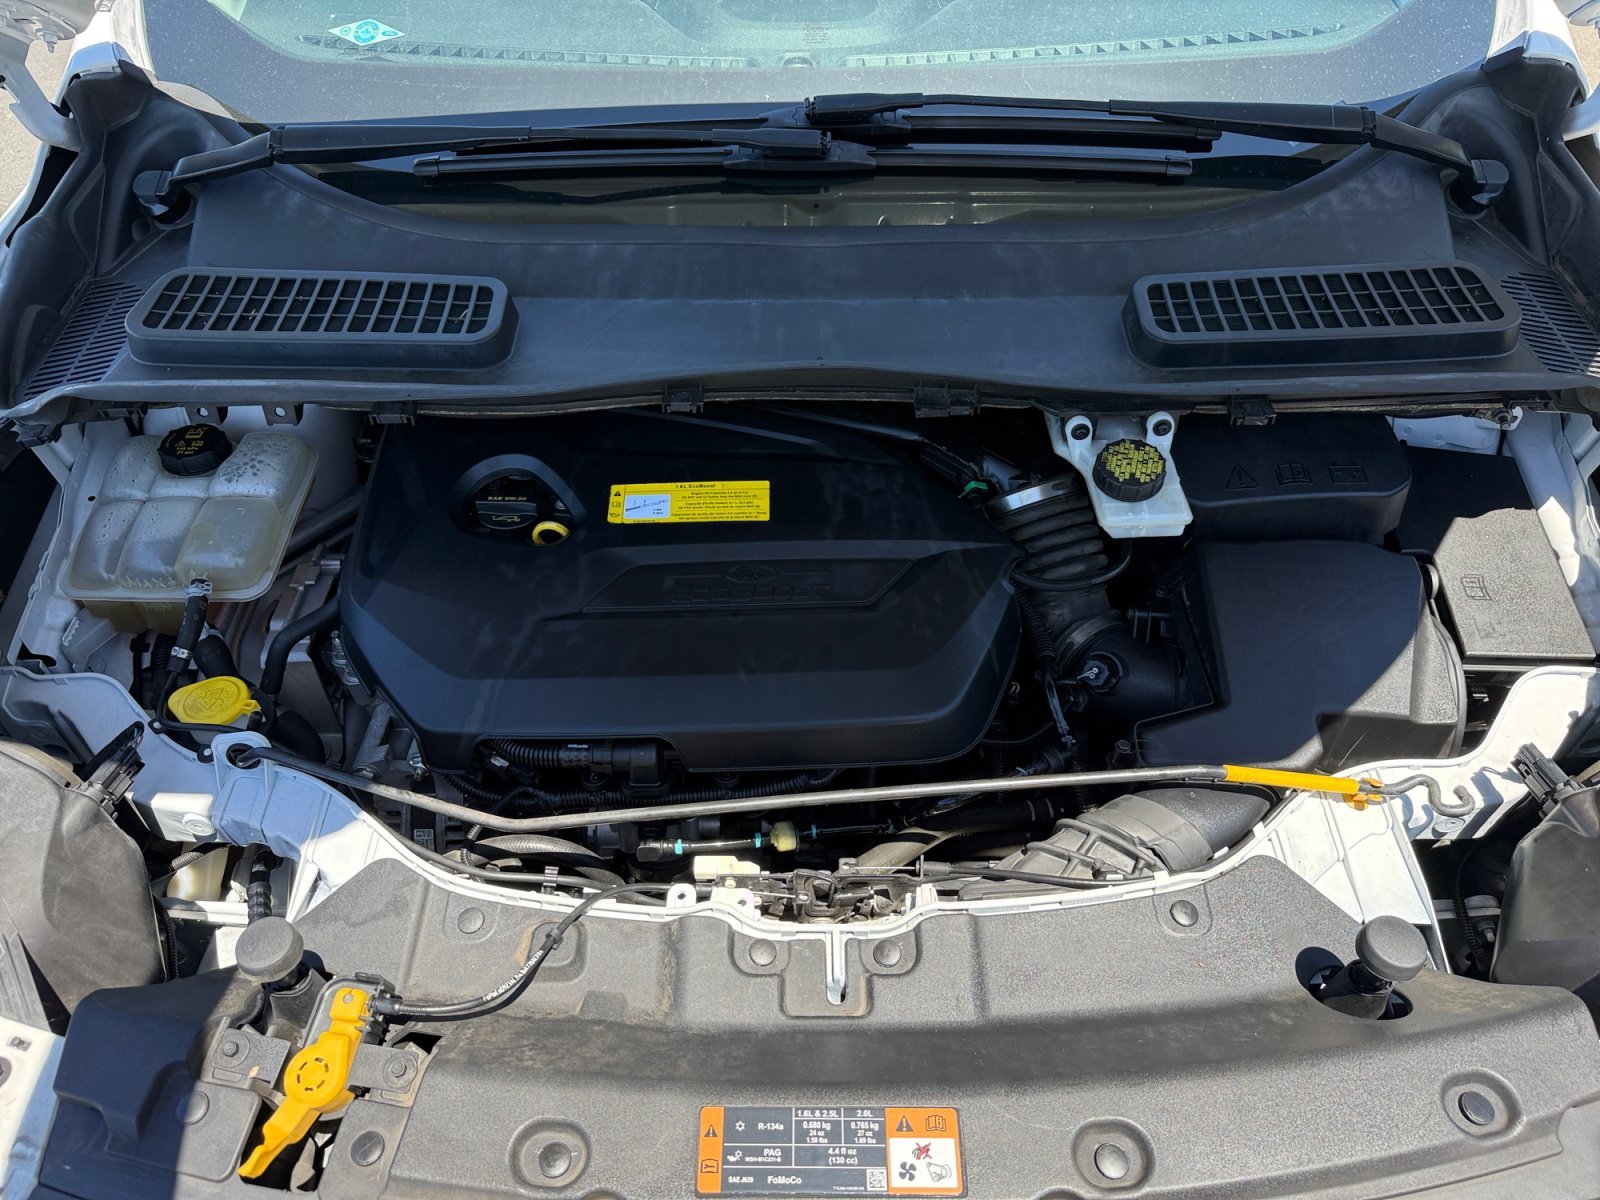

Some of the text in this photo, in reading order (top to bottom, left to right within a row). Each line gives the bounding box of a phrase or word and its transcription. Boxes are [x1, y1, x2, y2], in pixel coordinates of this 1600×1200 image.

[797, 1109, 839, 1118] 1.6L & 2.5L
[856, 1109, 874, 1118] 2.0L
[758, 1122, 784, 1131] R-134a
[822, 1121, 831, 1131] kg
[850, 1121, 879, 1131] 0.765 kg
[763, 1148, 782, 1156] PAG
[827, 1147, 840, 1155] 4.4
[840, 1147, 847, 1155] fl
[828, 1156, 858, 1165] (130 cc)
[767, 1175, 802, 1184] FoMoCo
